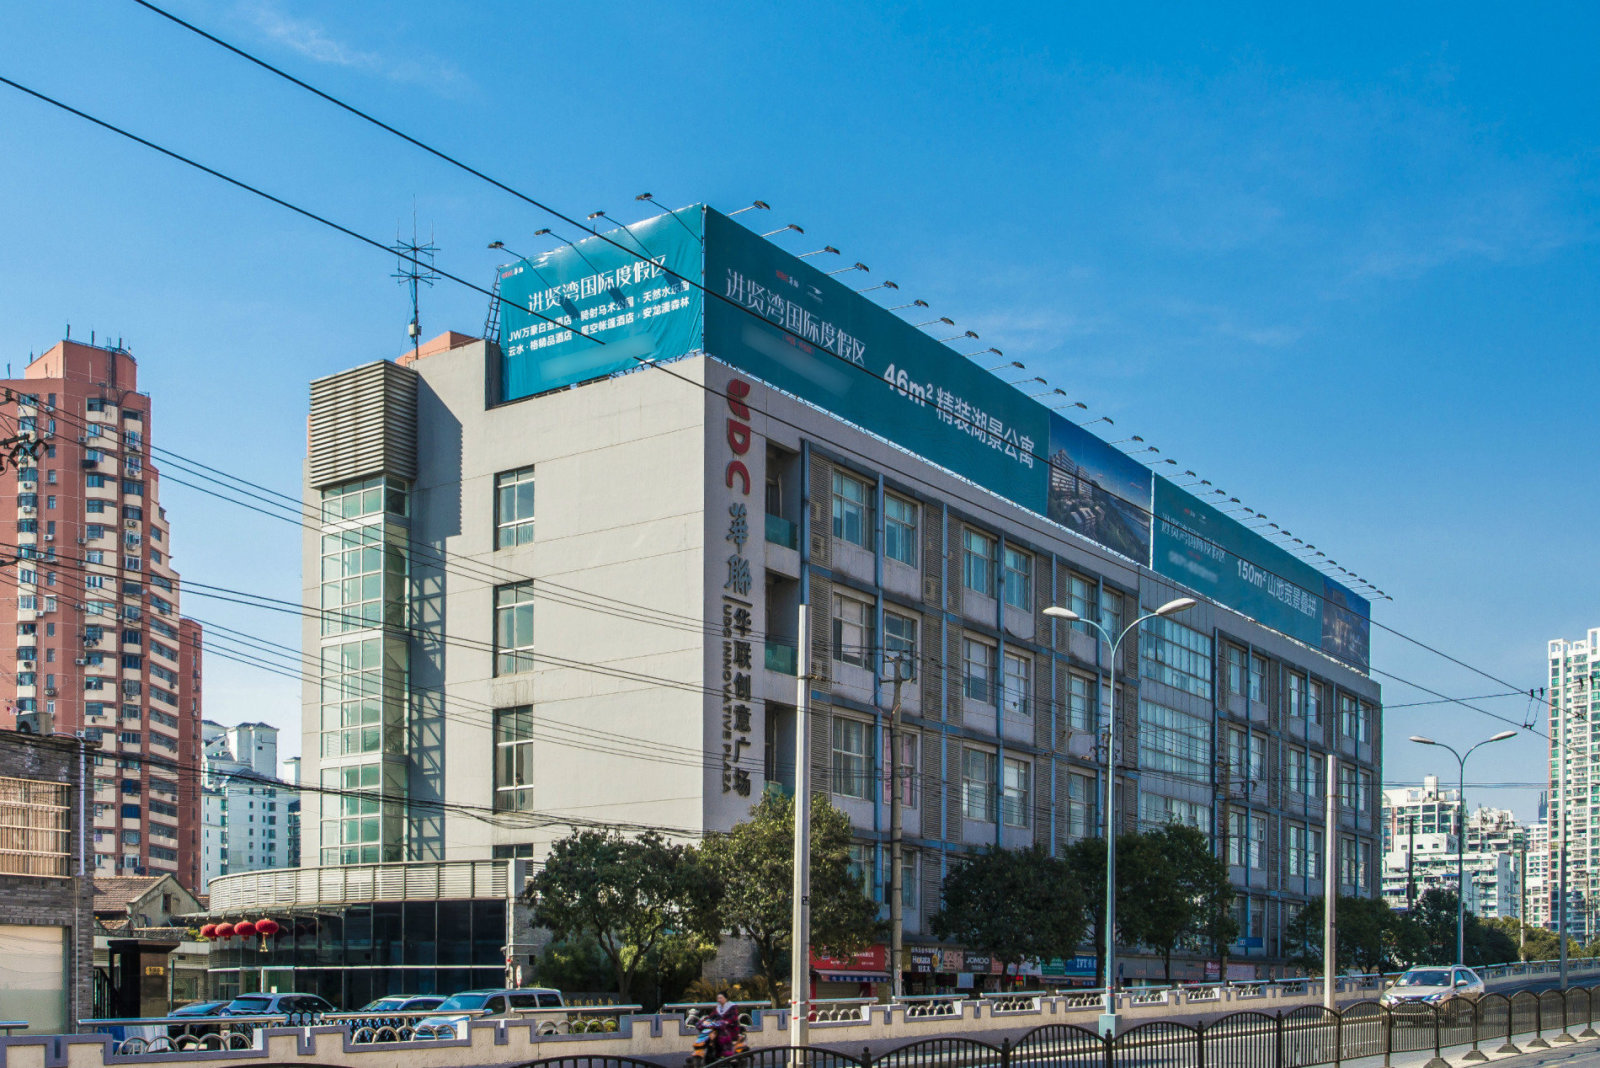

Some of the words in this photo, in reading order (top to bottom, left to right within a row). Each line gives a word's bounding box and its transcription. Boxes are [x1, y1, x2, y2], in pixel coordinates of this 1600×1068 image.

[528, 254, 667, 315] 进贤湾国际度假区
[725, 268, 866, 367] 进贤湾国际度假区
[936, 387, 1035, 469] 精装湖景公寓
[722, 641, 733, 740] INNOVATIVE
[733, 607, 752, 797] 华联创意广场
[722, 743, 733, 795] PLAZA
[966, 957, 990, 965] JOMOO
